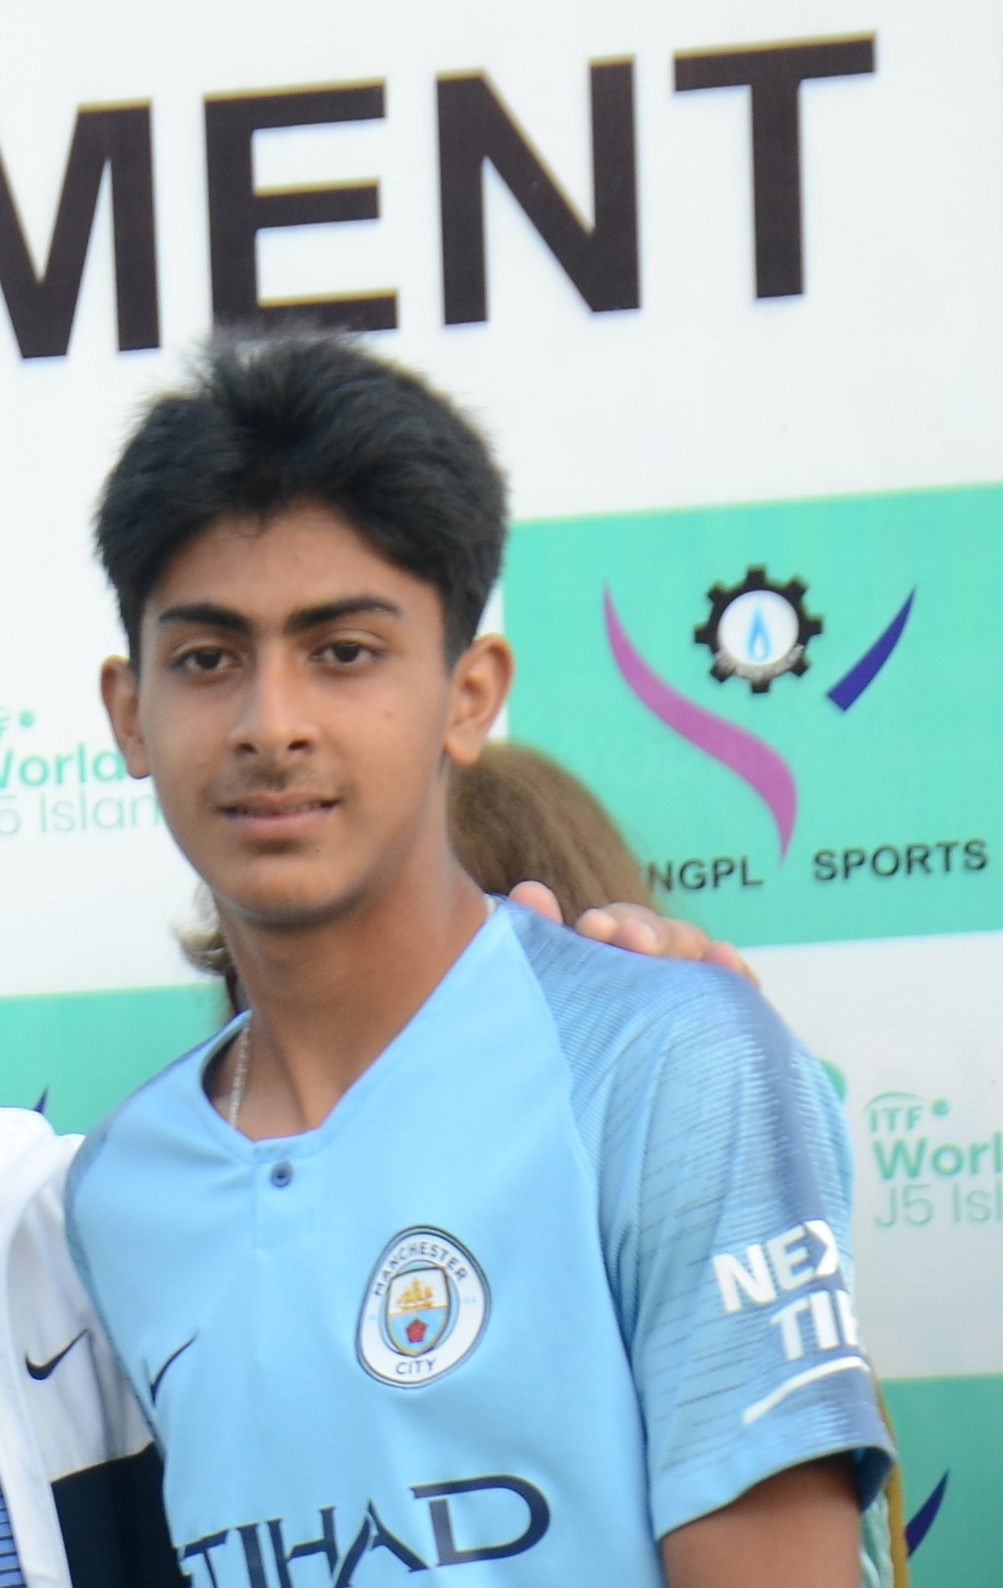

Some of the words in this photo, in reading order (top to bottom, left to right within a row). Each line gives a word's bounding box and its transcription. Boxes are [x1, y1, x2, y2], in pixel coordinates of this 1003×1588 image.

[813, 838, 989, 881] SPORTS
[869, 1105, 924, 1132] ITF
[874, 1184, 933, 1226] J5
[373, 1240, 468, 1297] MANCHESTER
[395, 1358, 438, 1375] CITY
